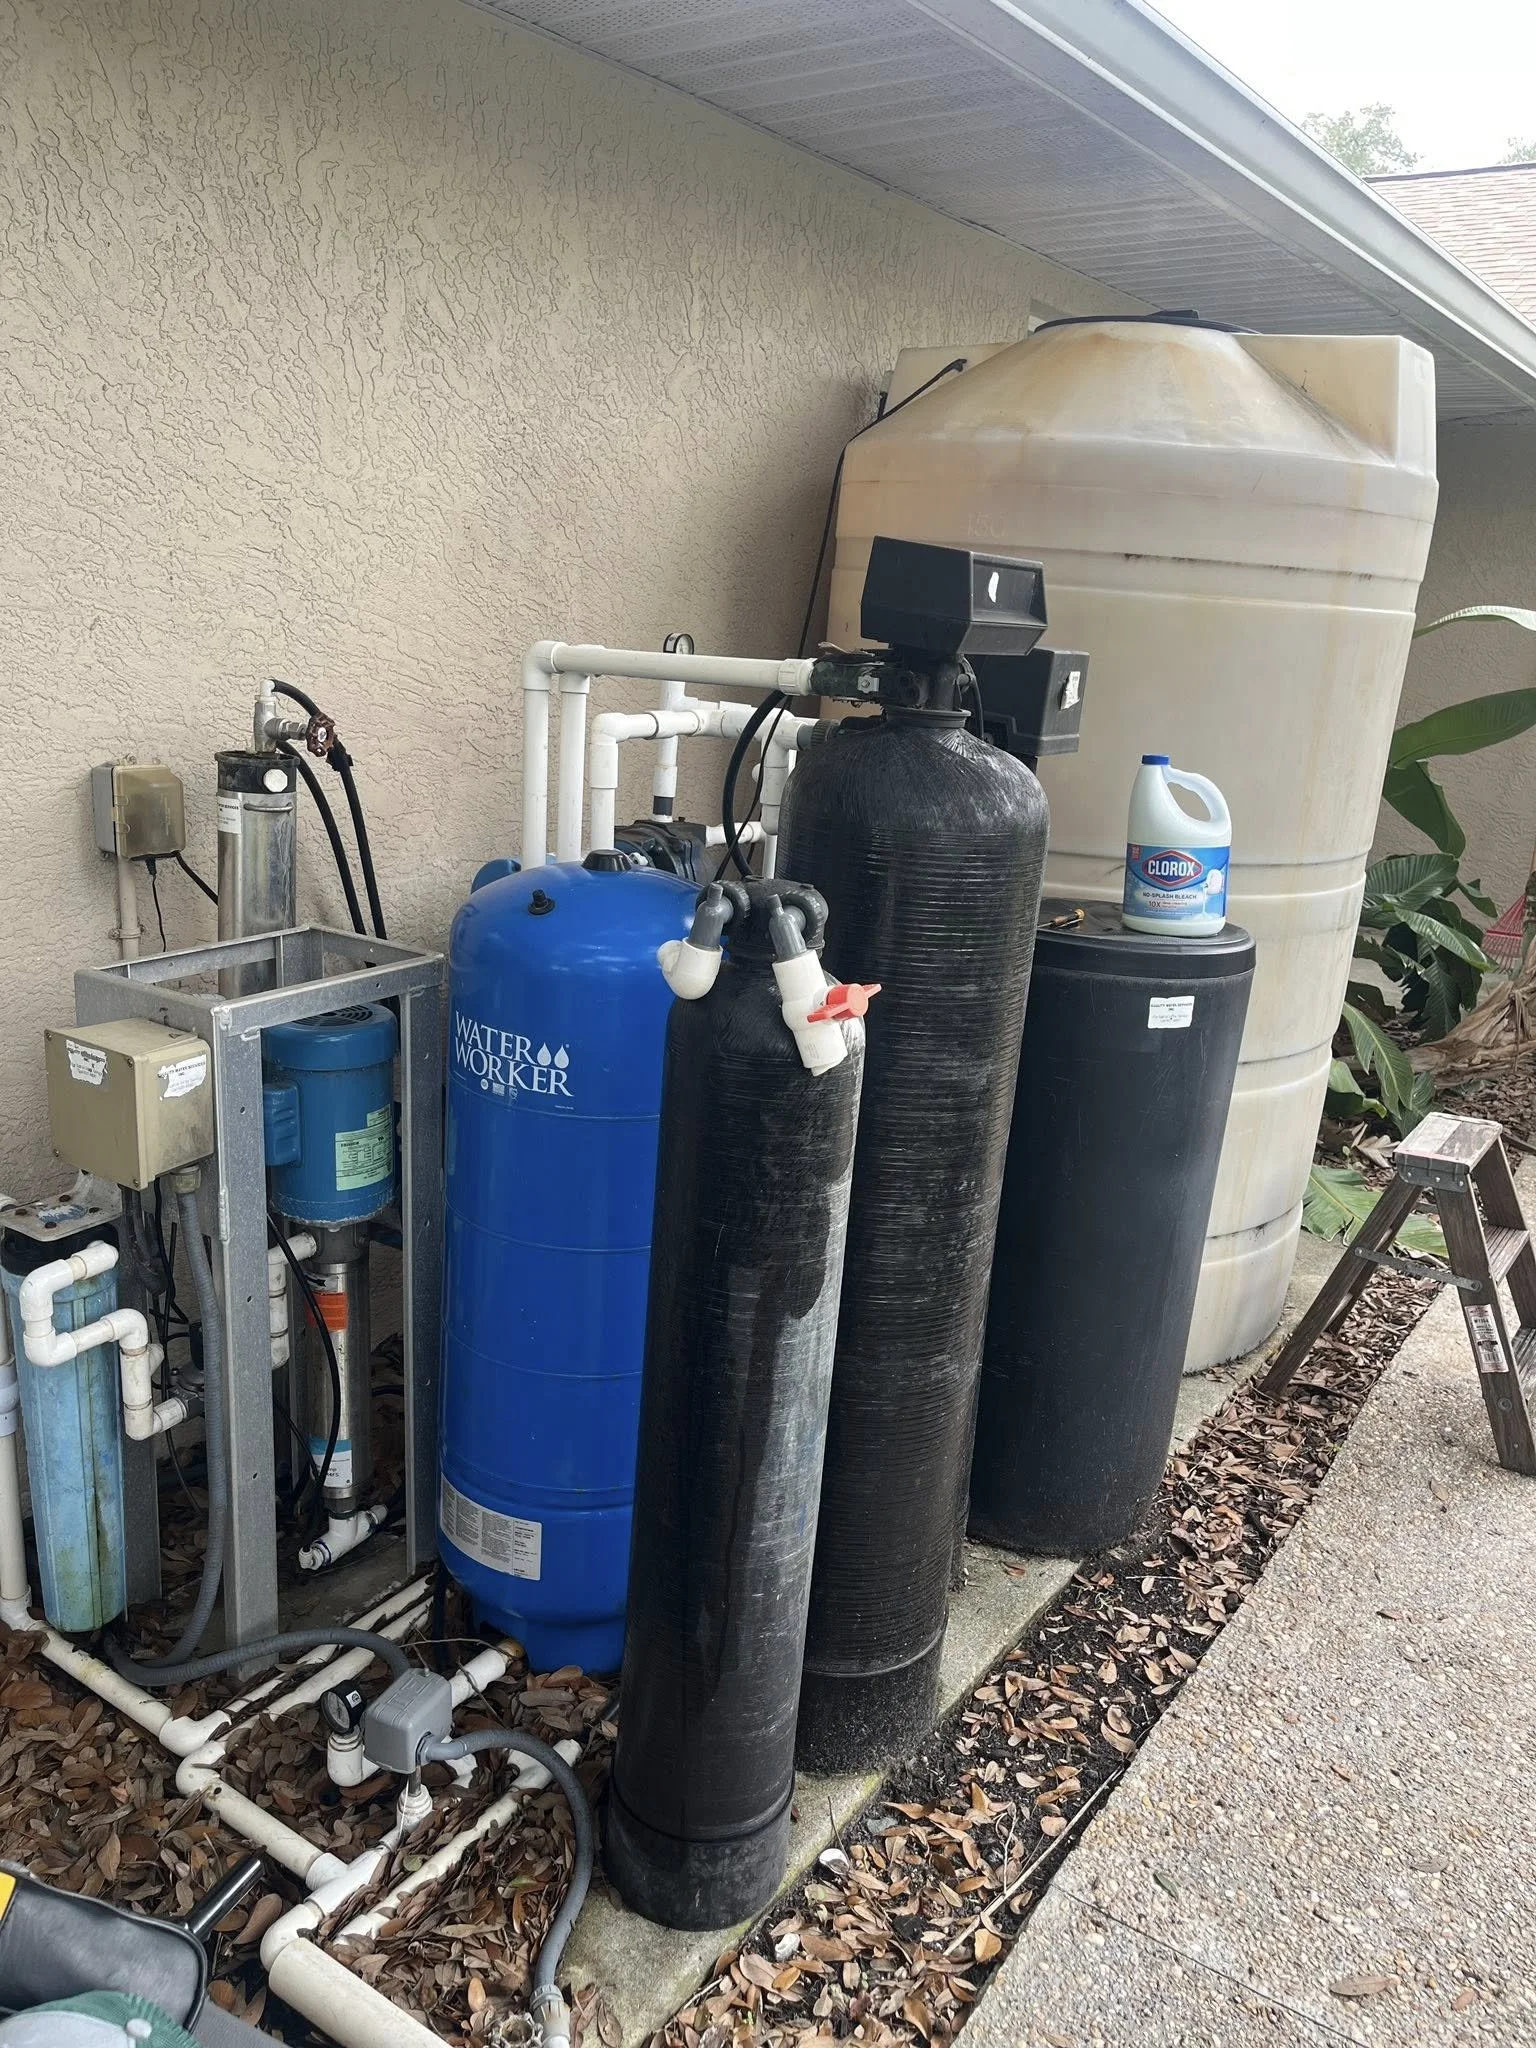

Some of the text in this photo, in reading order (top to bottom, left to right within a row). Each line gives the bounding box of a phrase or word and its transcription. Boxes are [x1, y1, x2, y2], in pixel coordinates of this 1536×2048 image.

[1148, 859, 1195, 877] CLOROX
[455, 1010, 538, 1066] WATER
[454, 1036, 575, 1097] WORKER
